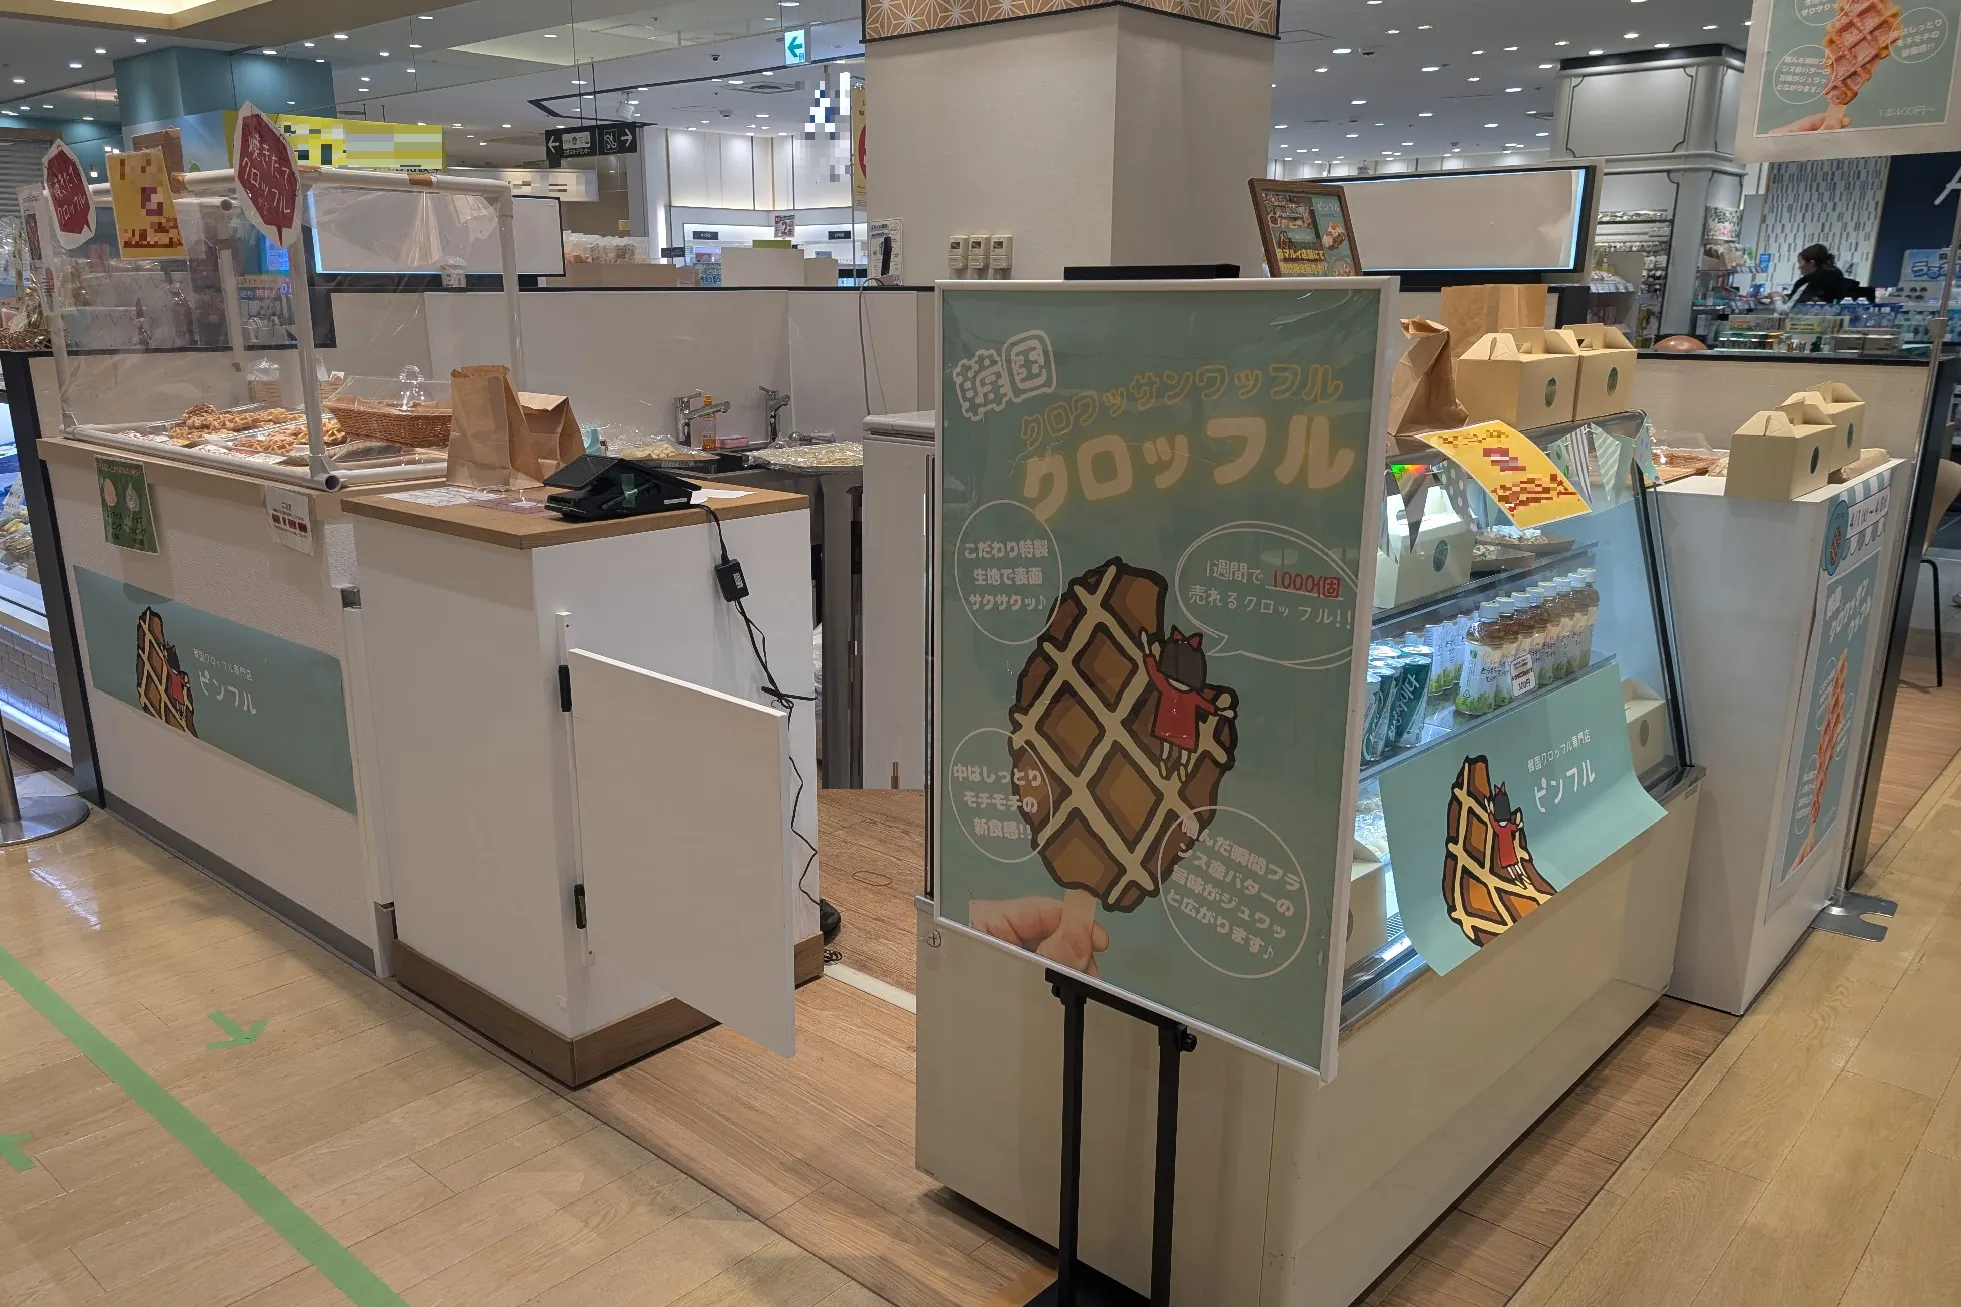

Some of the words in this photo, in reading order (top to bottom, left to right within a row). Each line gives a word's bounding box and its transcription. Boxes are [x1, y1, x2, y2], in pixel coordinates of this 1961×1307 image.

[241, 157, 291, 213] クロッフル
[952, 329, 1057, 422] 韓国
[1021, 363, 1344, 450] クロワッサンワッフル
[1023, 414, 1356, 522] クロッフル
[964, 539, 1049, 560] こだわり特製
[973, 566, 1043, 586] 生地で表面
[199, 669, 258, 715] ピンフル
[952, 762, 1042, 788] 中はしっとり
[1527, 729, 1592, 774] 韓国クロッフル専門店
[963, 790, 1038, 814] モチモチの
[1534, 759, 1597, 813] ピンフル
[1170, 864, 1288, 939] 旨味がジュワッ
